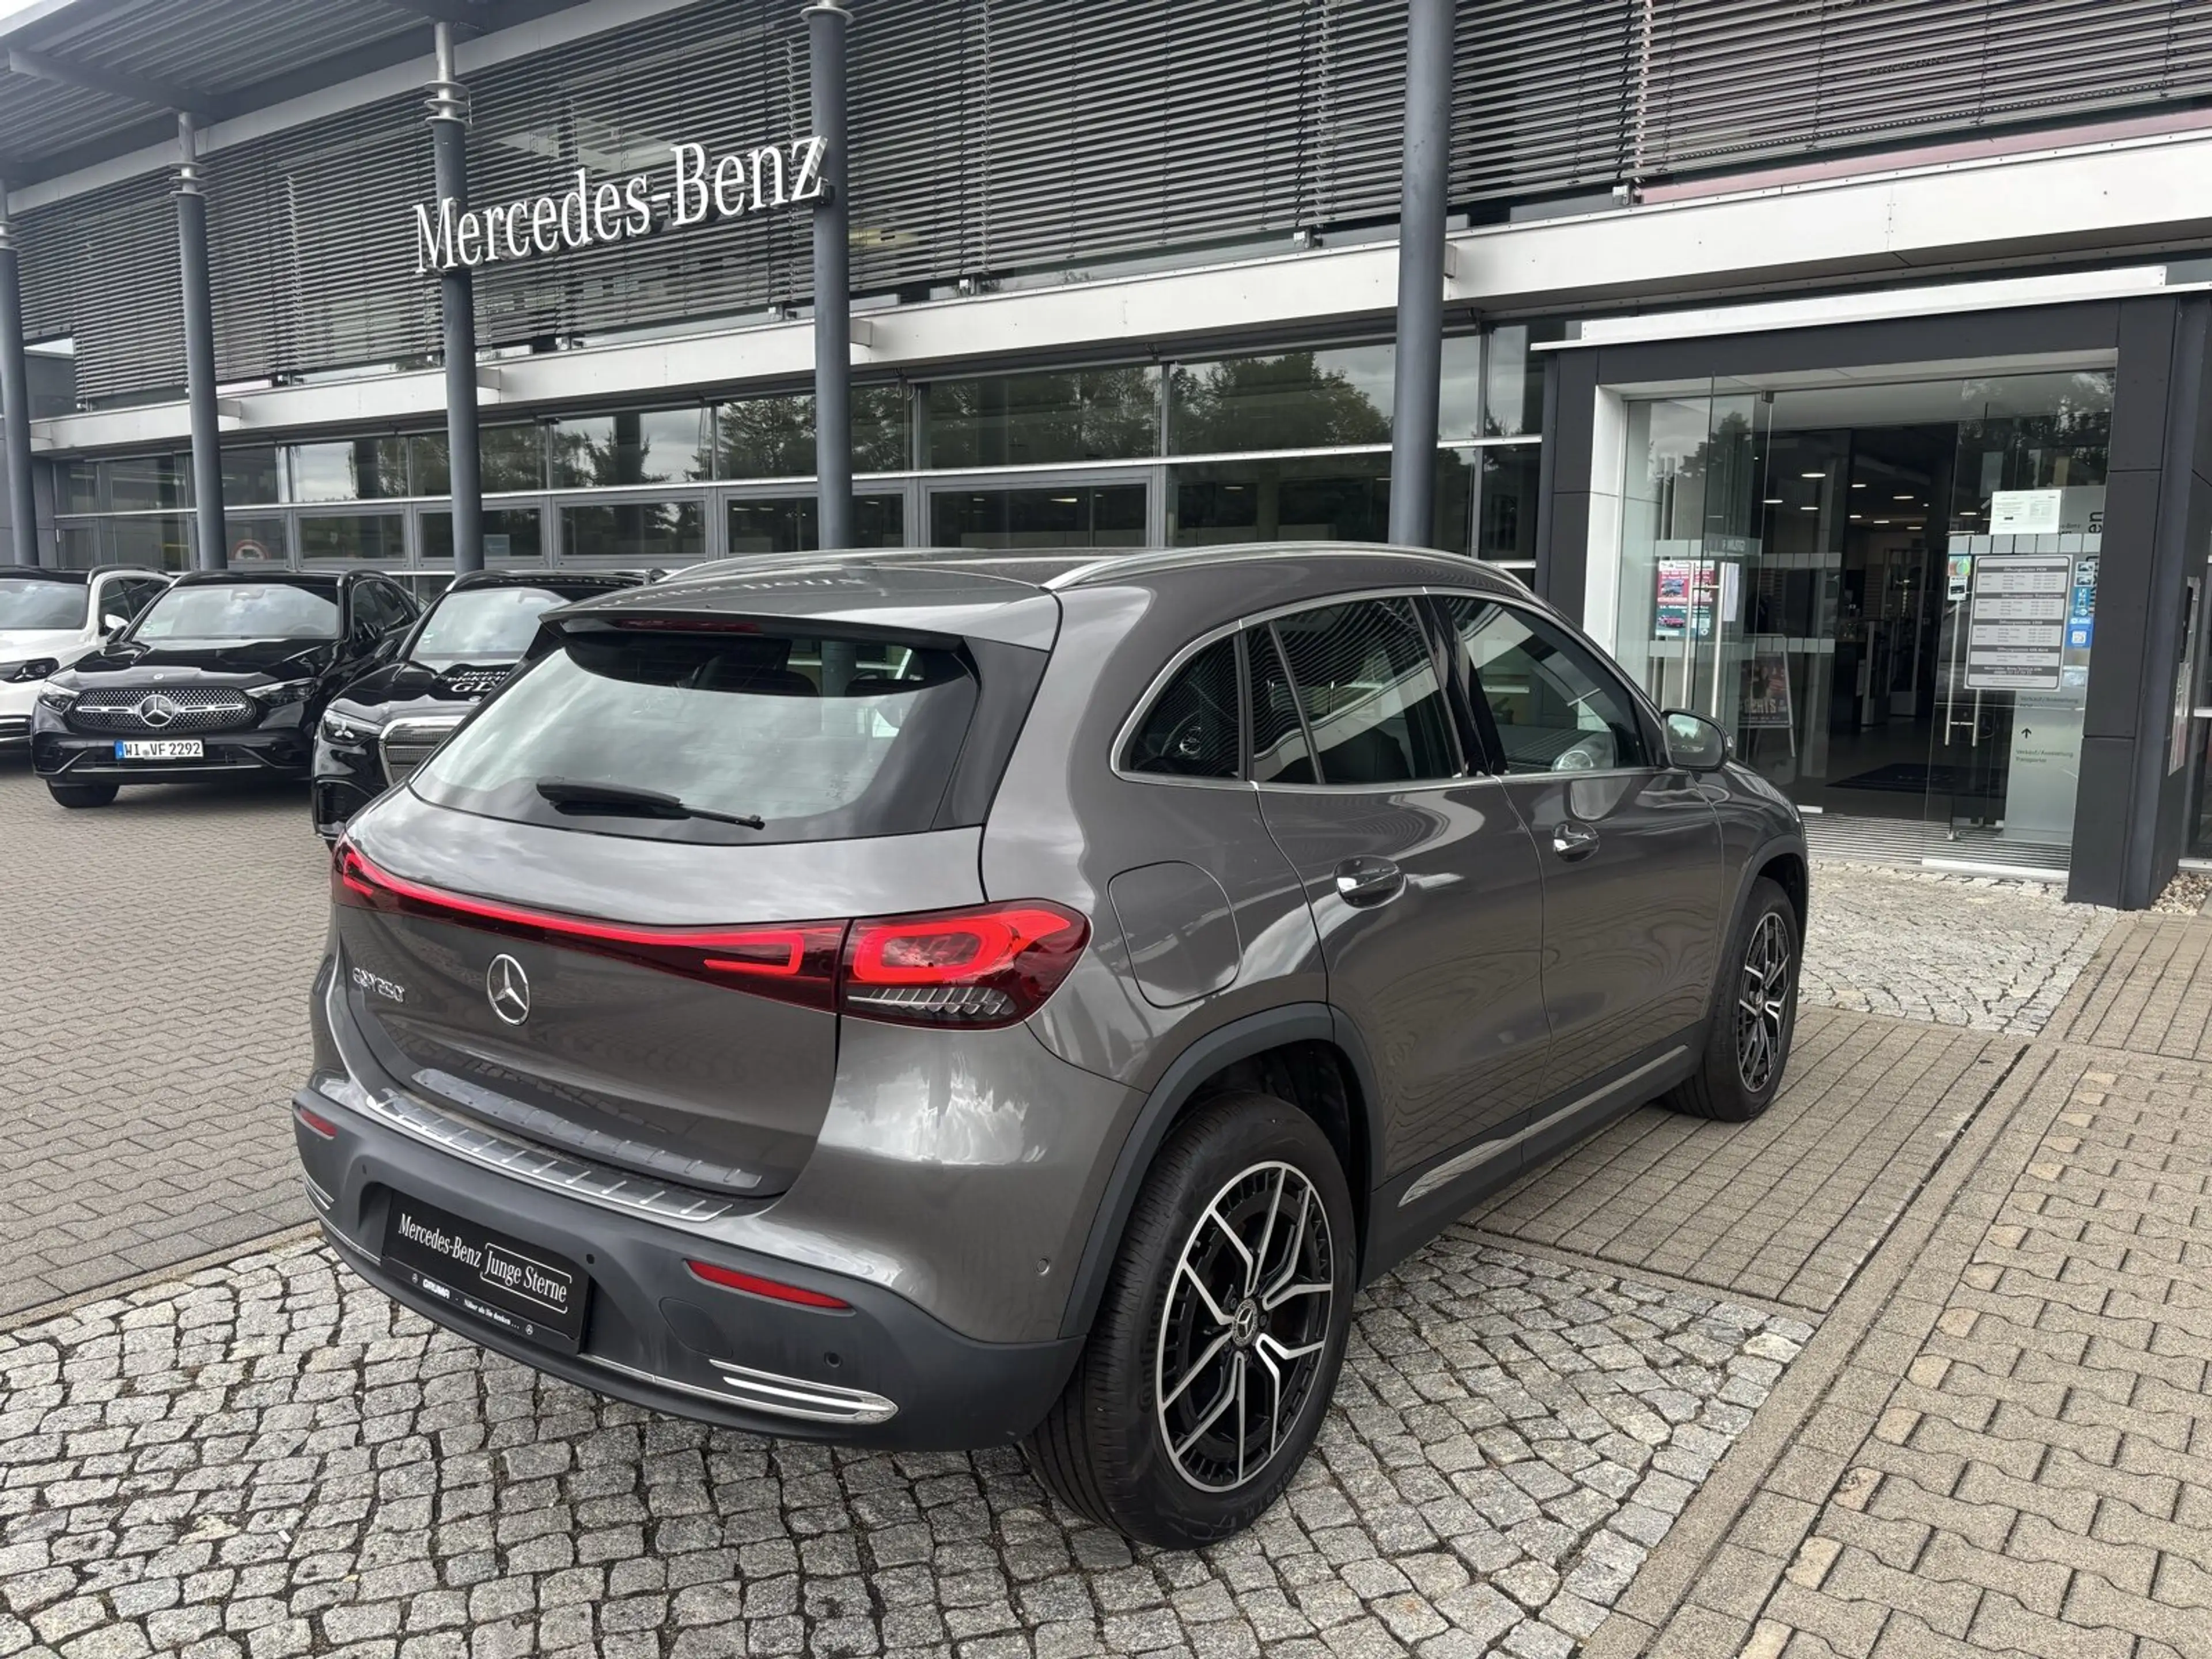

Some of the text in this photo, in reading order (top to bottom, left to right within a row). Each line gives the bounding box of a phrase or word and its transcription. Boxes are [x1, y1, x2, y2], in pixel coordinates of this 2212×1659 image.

[413, 135, 828, 274] Mercedes-Benz
[124, 742, 201, 756] WI VF 2292
[397, 1213, 567, 1304] Mercedes-Benz Junge Sterne
